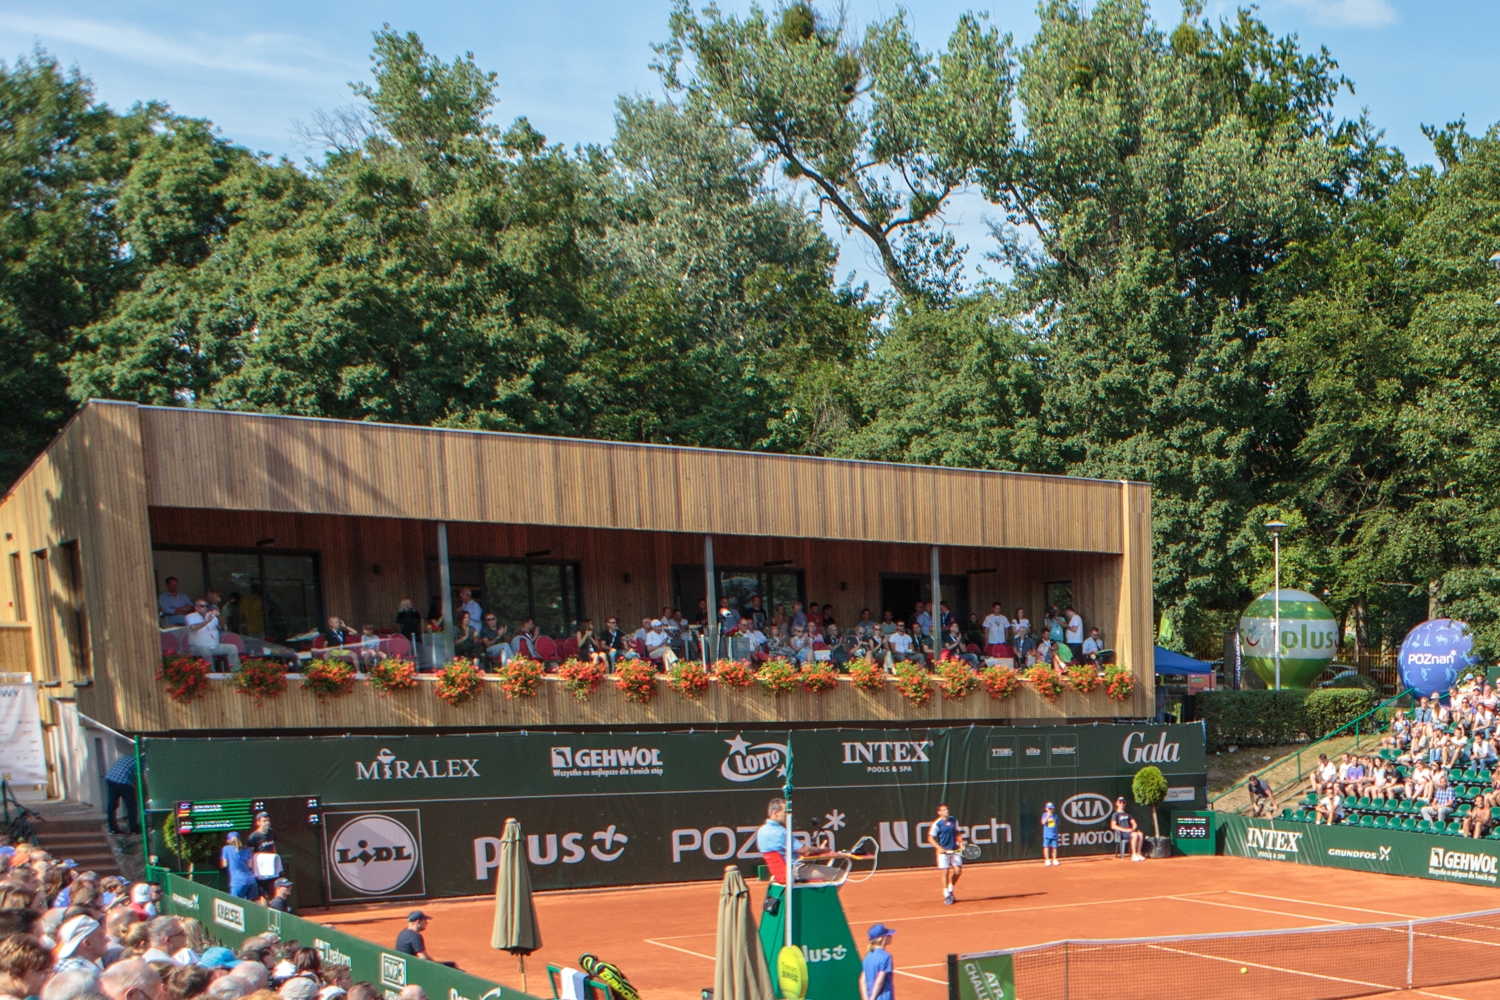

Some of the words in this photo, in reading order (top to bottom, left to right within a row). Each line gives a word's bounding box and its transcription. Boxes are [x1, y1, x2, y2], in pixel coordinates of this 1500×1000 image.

[1281, 624, 1334, 650] plus
[575, 747, 663, 768] GEHWOL
[842, 741, 930, 764] INTEX
[1123, 731, 1180, 764] Gala
[356, 753, 481, 780] MIRALEX
[736, 750, 780, 775] LOTTO
[899, 765, 913, 773] SPA
[1071, 801, 1105, 818] KIA
[916, 818, 1012, 848] Cech
[1073, 830, 1120, 846] MOTO
[1247, 828, 1299, 853] INTEX
[474, 833, 586, 880] pus
[1328, 848, 1377, 860] GRUNDFOS
[1444, 851, 1498, 874] GEHWOL
[801, 944, 832, 962] lus
[983, 971, 1005, 1000] ATP
